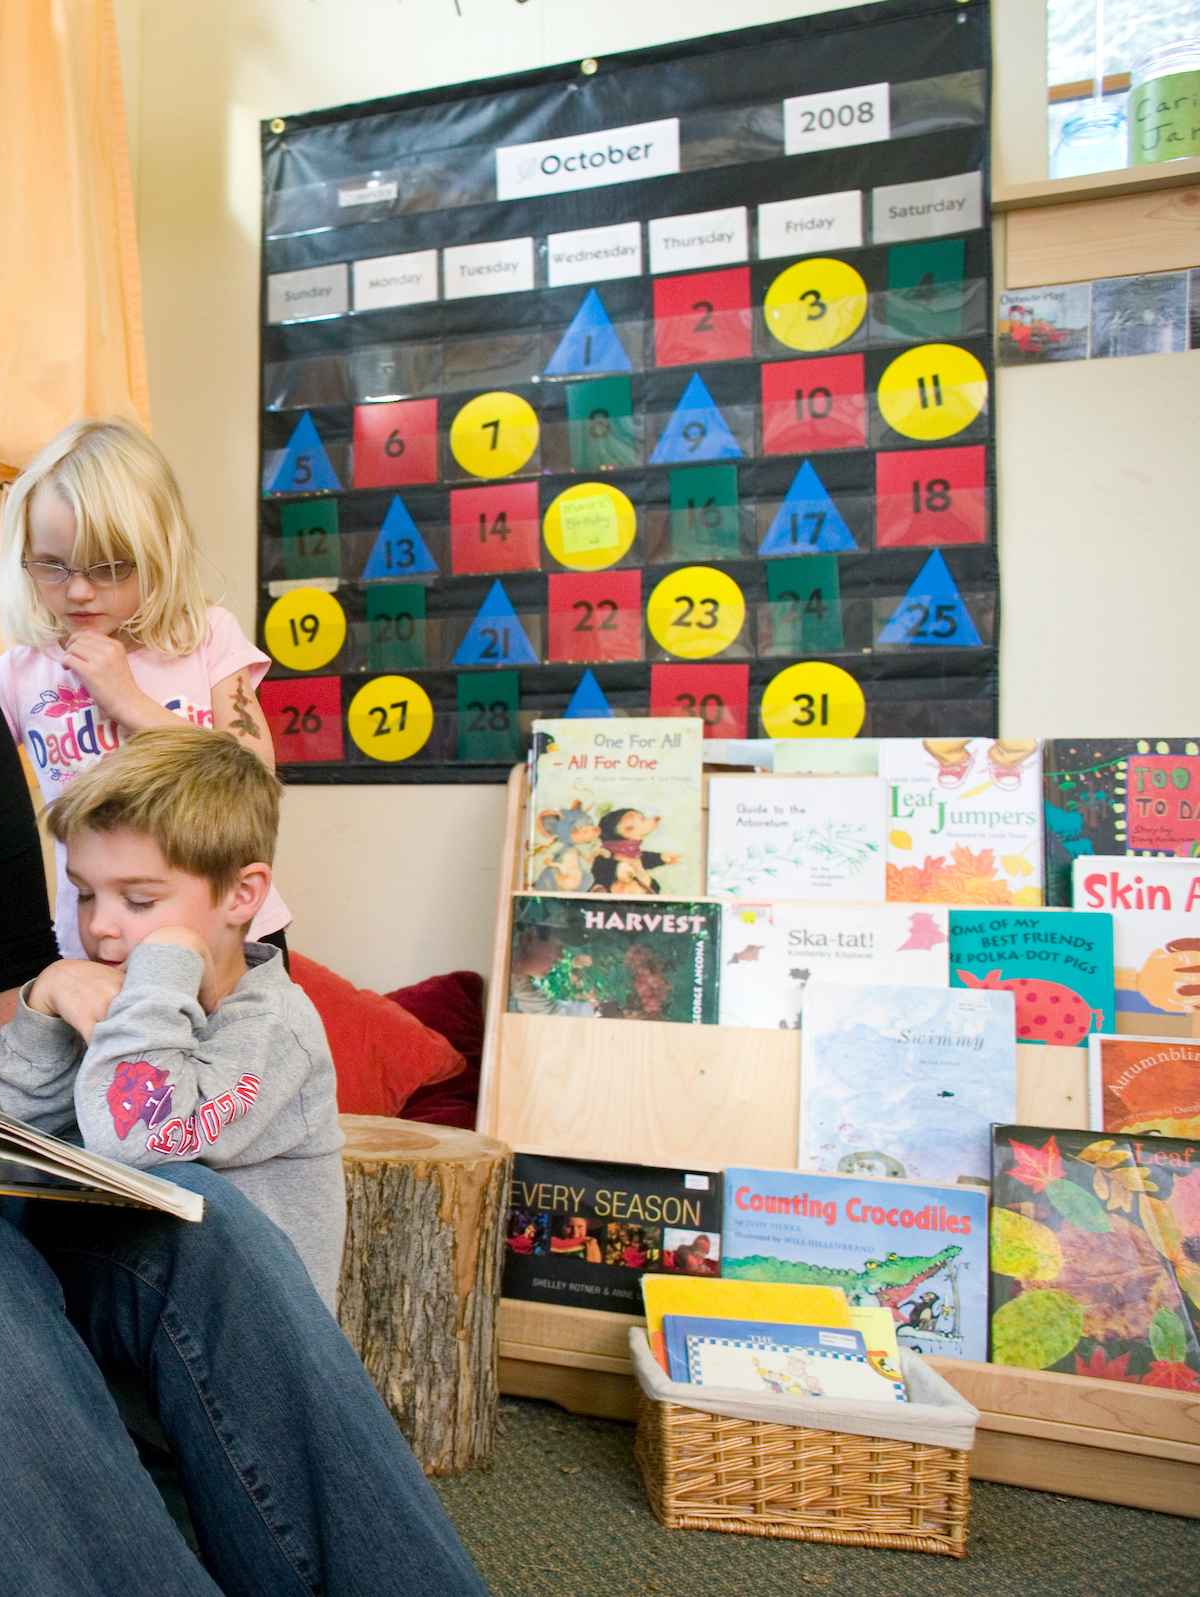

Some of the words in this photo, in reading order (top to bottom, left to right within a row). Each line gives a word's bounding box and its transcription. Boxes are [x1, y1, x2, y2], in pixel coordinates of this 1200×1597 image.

[800, 101, 875, 134] 2008
[540, 141, 654, 175] October
[284, 284, 333, 303] Sunday
[368, 271, 424, 294] Monday
[458, 261, 521, 281] Tuesday
[551, 244, 638, 266] Wednesday
[662, 229, 736, 253] Thursday
[785, 215, 836, 236] Friday
[888, 196, 967, 221] Saturday
[911, 271, 935, 305] 4
[691, 301, 715, 332] 2
[799, 289, 828, 321] 3
[795, 386, 833, 421] 10
[916, 373, 944, 409] 11
[481, 419, 501, 451] 7
[588, 408, 611, 440] 8
[682, 422, 707, 452] 9
[384, 429, 405, 458] 6
[292, 455, 313, 484] 5
[911, 478, 951, 514] 18
[478, 511, 512, 543] 14
[686, 497, 723, 530] 16
[789, 511, 827, 546] 17
[297, 526, 329, 557] 12
[384, 537, 416, 570] 13
[572, 599, 619, 632] 22
[670, 595, 720, 630] 23
[777, 587, 828, 622] 24
[289, 613, 320, 647] 19
[373, 611, 416, 643] 20
[904, 603, 957, 639] 25
[479, 627, 510, 659] 21
[281, 705, 323, 736] 26
[368, 700, 410, 738] 27
[466, 701, 510, 733] 28
[675, 693, 725, 727] 30
[791, 693, 829, 727] 31
[594, 733, 624, 749] One
[629, 734, 656, 748] For
[661, 733, 682, 749] All
[567, 754, 588, 770] All
[594, 755, 621, 769] For
[627, 754, 658, 770] One
[1134, 767, 1191, 793] TOO
[736, 803, 768, 814] Guide
[774, 804, 784, 814] to
[790, 804, 806, 814] the
[890, 785, 937, 818] Leaf
[1135, 798, 1167, 817] TO
[736, 817, 789, 828] Arboretum
[930, 802, 1036, 835] Jumpers
[1083, 872, 1171, 911] Skin
[585, 911, 706, 933] HARVEST
[949, 922, 986, 936] OME
[990, 920, 1008, 931] OF
[1014, 919, 1040, 929] MY
[788, 929, 874, 948] Ska-tat!
[981, 934, 1019, 949] BEST
[1023, 932, 1095, 952] FRIENDS
[693, 940, 705, 985] ANCONA
[967, 950, 1060, 963] POLKA-DOT
[1064, 955, 1098, 974] PIGS
[692, 986, 704, 1024] GEORGE
[897, 1028, 984, 1051] Swimmy
[1134, 1143, 1195, 1168] Leaf
[509, 1180, 586, 1212] EVERY
[595, 1190, 700, 1226] SEASON
[735, 1187, 837, 1226] Counting
[846, 1198, 971, 1234] Crocodiles
[734, 1219, 743, 1227] by
[746, 1220, 767, 1228] JUDY
[770, 1223, 801, 1232] SIERRA
[734, 1231, 770, 1241] Illustrated
[772, 1235, 781, 1243] by
[784, 1237, 805, 1245] WILL
[532, 1278, 566, 1290] SHELLEY
[569, 1283, 601, 1295] ROTNER
[603, 1287, 610, 1296] &
[748, 1335, 774, 1345] THE
